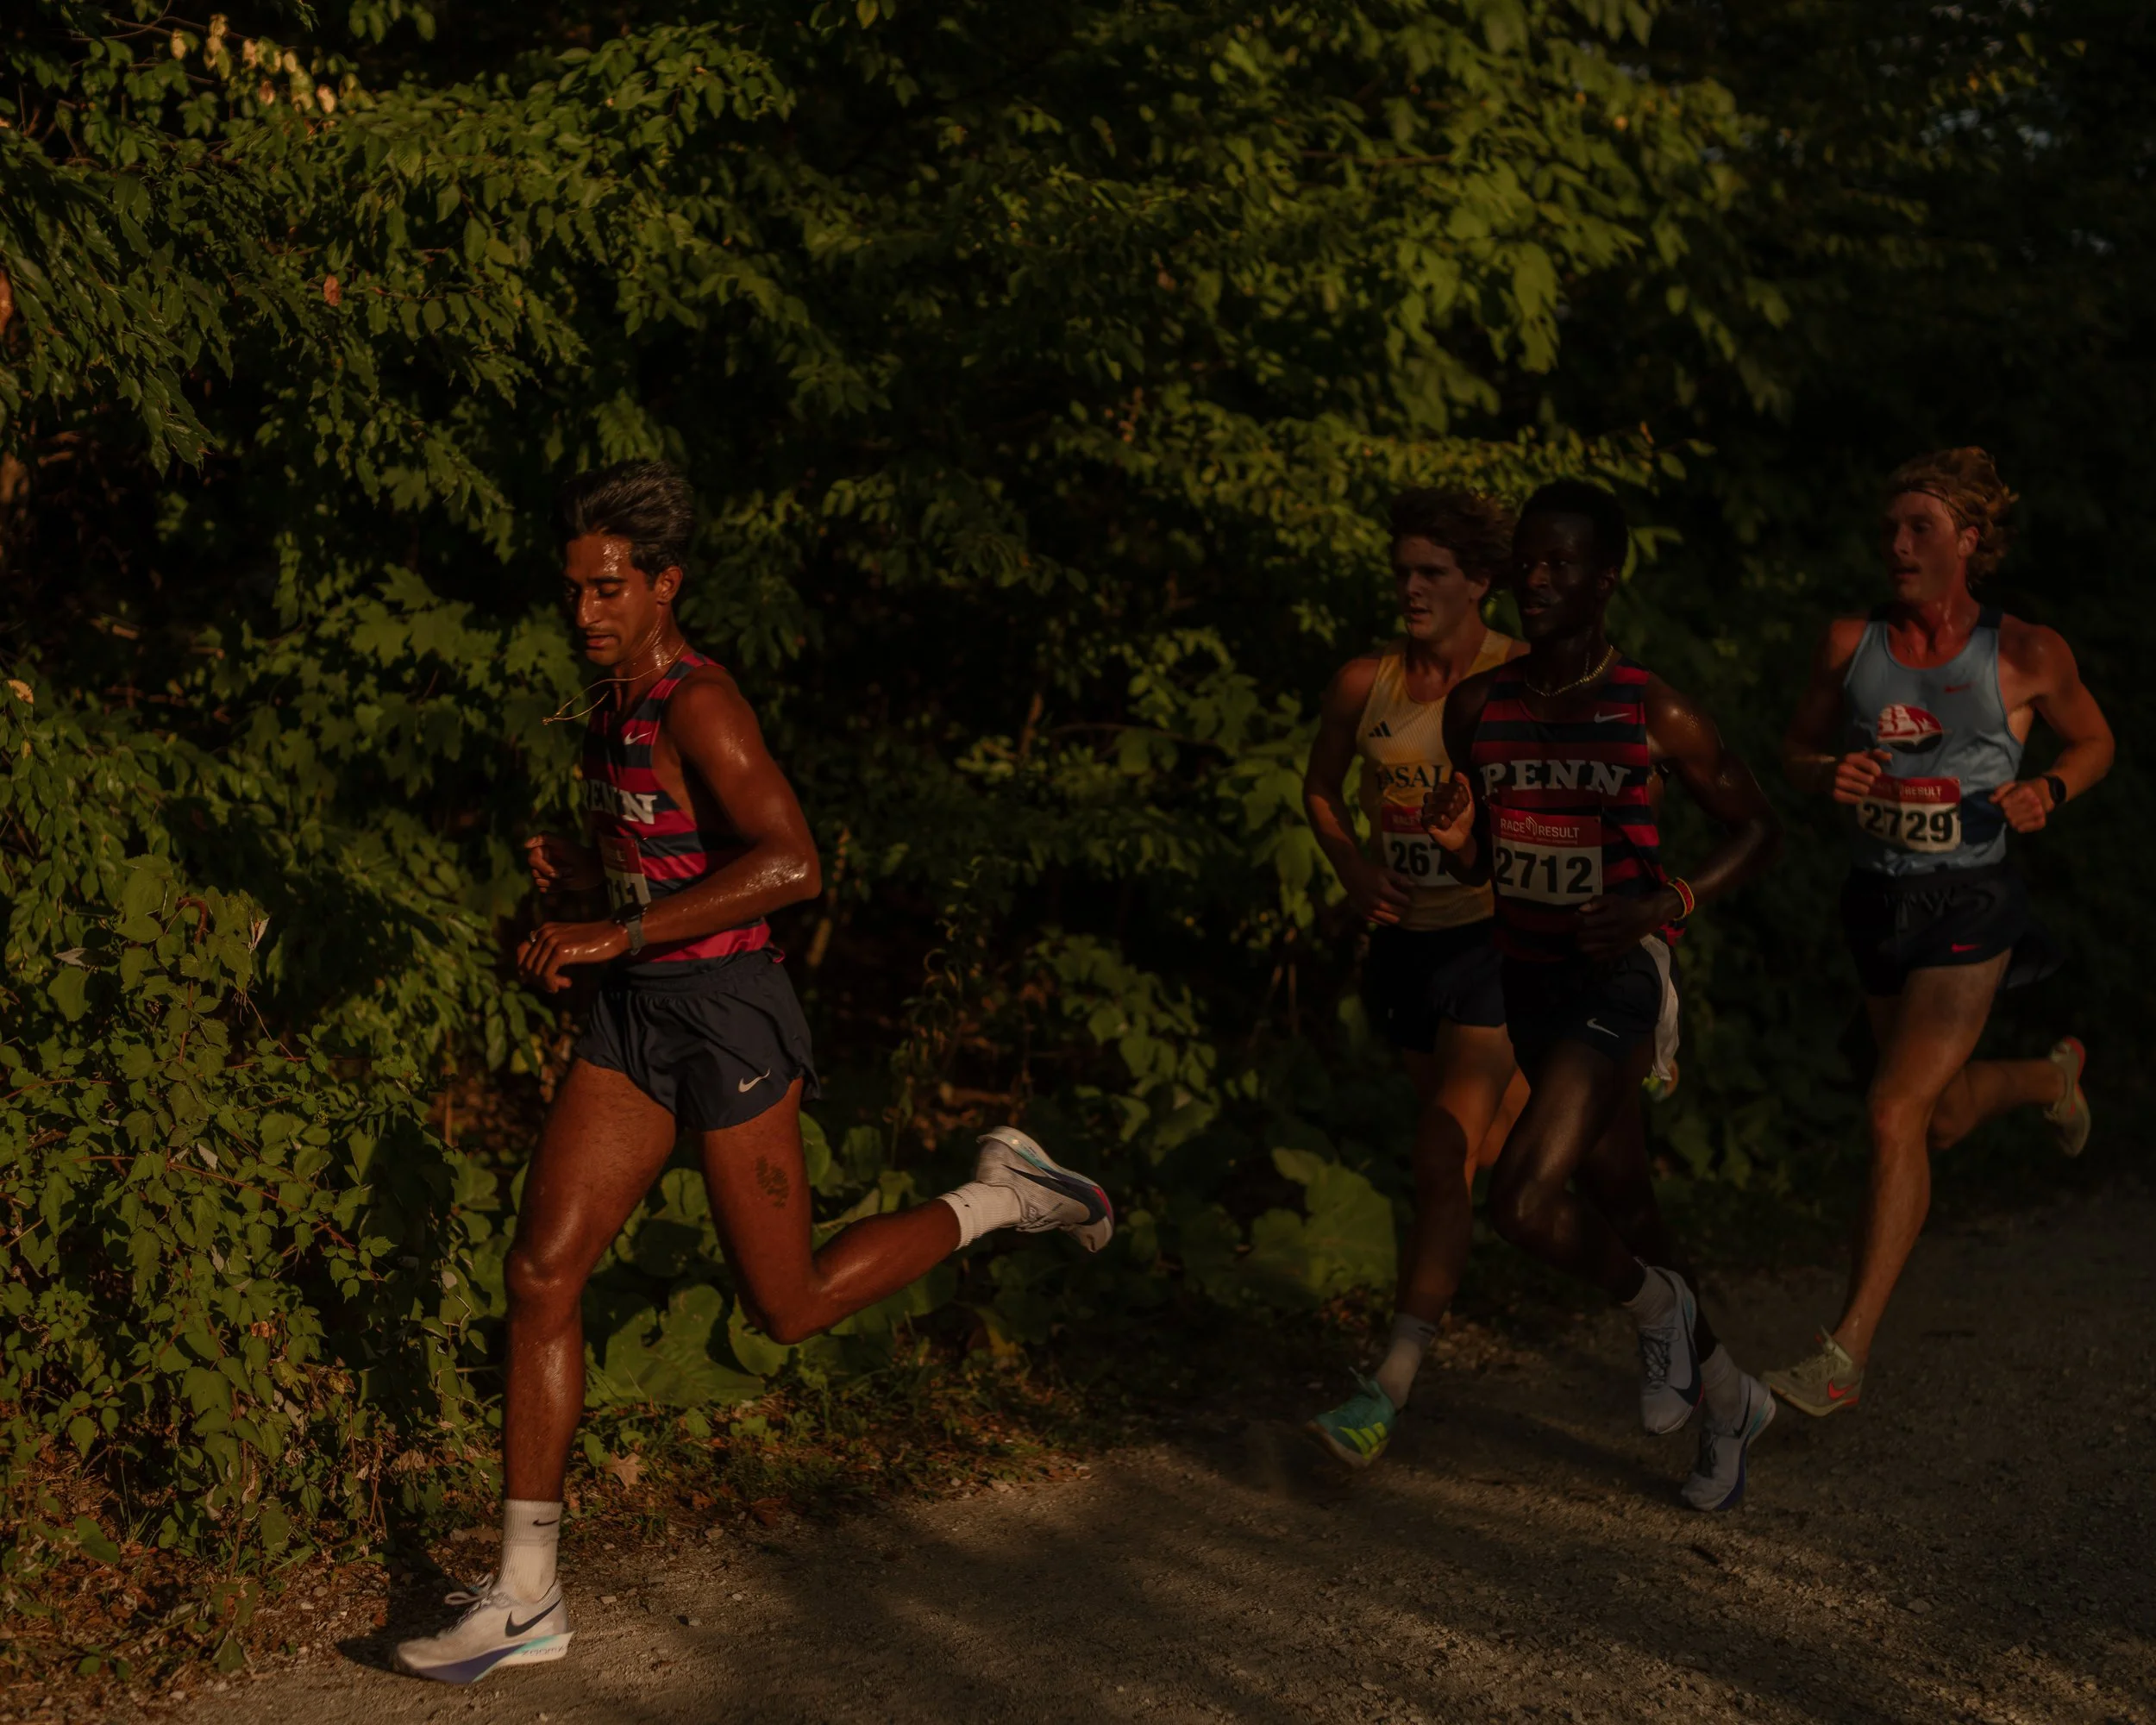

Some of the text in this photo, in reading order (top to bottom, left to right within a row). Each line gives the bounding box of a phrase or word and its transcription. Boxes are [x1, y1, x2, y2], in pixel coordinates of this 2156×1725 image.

[1480, 759, 1631, 797] PENN
[1500, 818, 1526, 834] RACE
[1538, 825, 1580, 838] RESULT
[1864, 802, 1953, 842] 2729
[1495, 847, 1593, 894] 2712
